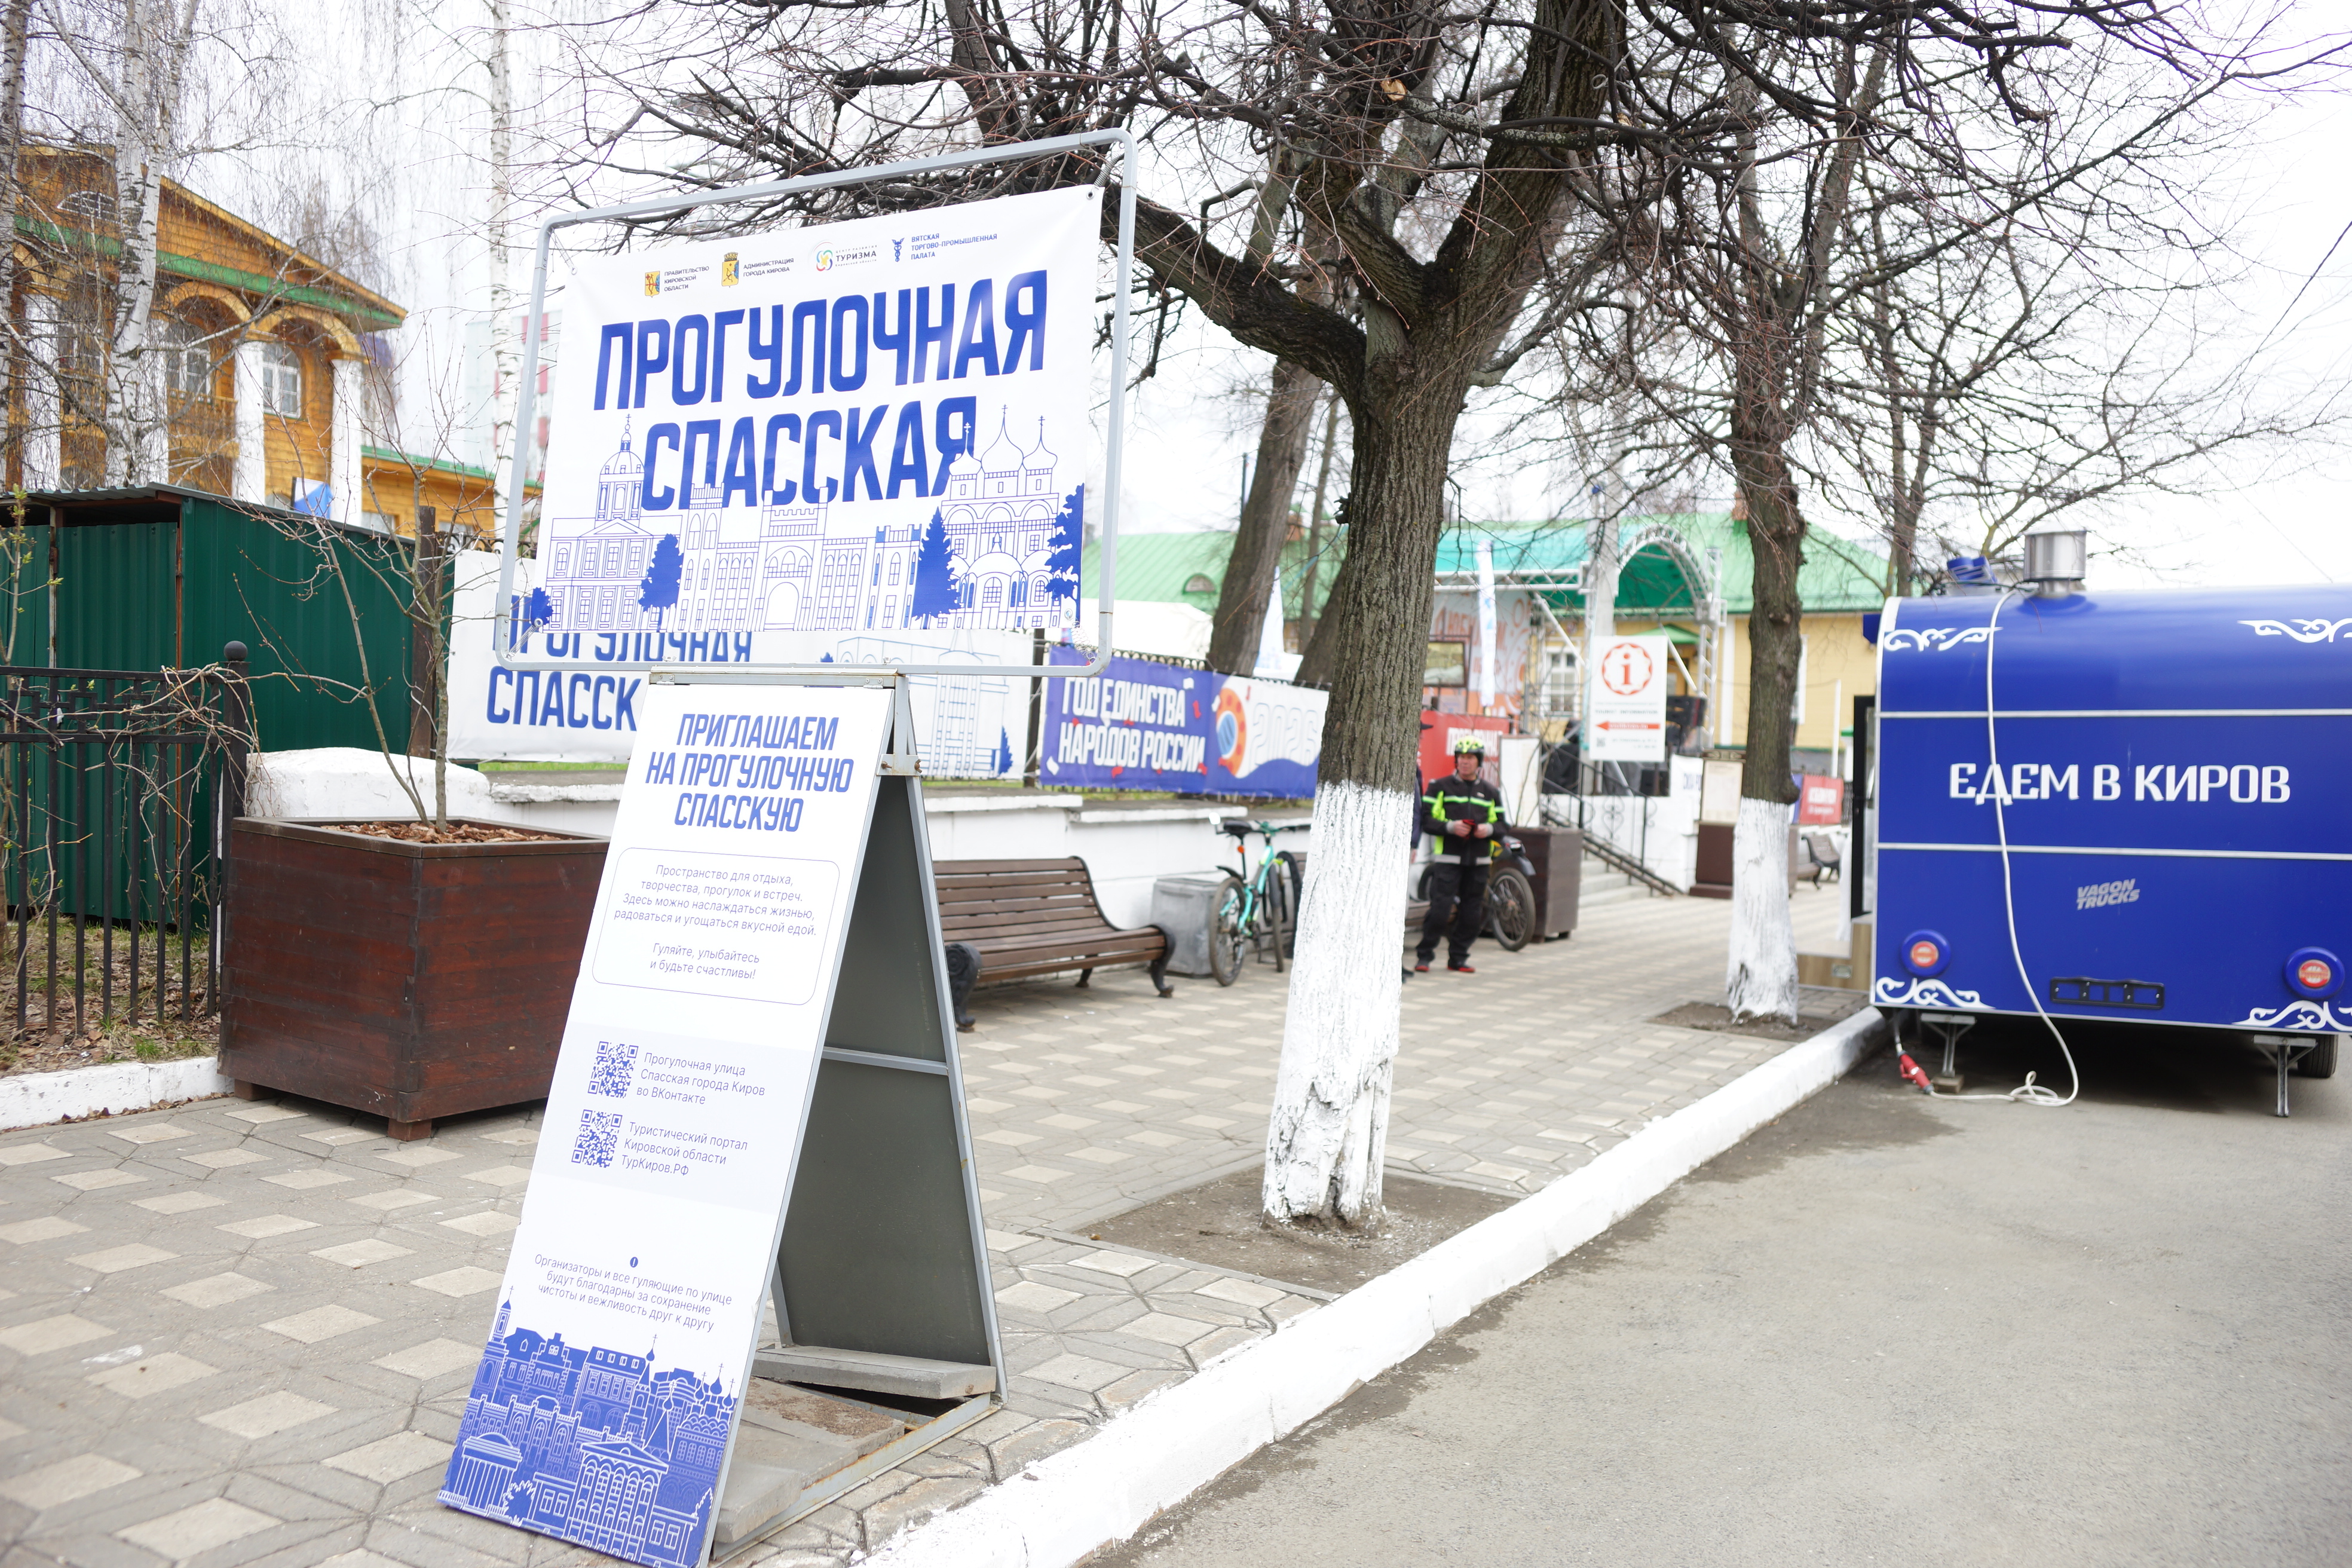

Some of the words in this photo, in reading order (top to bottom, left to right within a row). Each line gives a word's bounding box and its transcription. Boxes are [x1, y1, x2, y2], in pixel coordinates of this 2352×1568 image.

[911, 233, 939, 243] ВЯТСКАЯ
[911, 234, 997, 252] ТОРГОВО-ПРОМЫШЛЕННАЯ
[743, 258, 794, 269] АДМИНИСТРАЦИЯ
[836, 250, 877, 262] ТУРИЗМА
[911, 252, 936, 260] ПАЛАТА
[664, 266, 709, 277] ПРАВИТЕЛЬСТВО
[664, 274, 696, 284] КИРОВСКОЙ
[593, 269, 1048, 411] ПРОГУЛОЧНАЯ
[642, 396, 977, 511] СПАССКАЯ
[486, 666, 641, 731] СПАССК
[1062, 677, 1100, 718] ГОД
[1101, 678, 1186, 727] ЕДИНСТВА
[676, 713, 839, 751] ПРИГЛАШАЕМ
[1058, 721, 1141, 768] НАРОДОВ
[1141, 730, 1205, 773] РОССИИ
[645, 752, 676, 785] НА
[679, 753, 854, 792] ПРОГУЛОЧНУЮ
[1950, 763, 2080, 806] ЕДЕМ
[2093, 764, 2121, 801] В
[2134, 764, 2290, 803] КИРОВ
[674, 792, 804, 832] СПАССКУЮ
[656, 865, 728, 880] Пространство
[730, 872, 749, 882] для
[753, 874, 792, 886] отдыха,
[2077, 878, 2136, 898] VAGON
[642, 881, 700, 895] творчества,
[704, 887, 752, 898] прогулок
[763, 891, 802, 902] встреч.
[2076, 889, 2140, 910] TRUCKS
[623, 893, 652, 905] Здесь
[656, 899, 689, 908] можно
[692, 901, 767, 914] наслаждаться
[770, 908, 814, 921] жизнью,
[614, 911, 672, 922] радоваться
[684, 917, 739, 928] угощаться
[742, 921, 784, 932] вкусной
[788, 926, 816, 936] едой.
[653, 943, 694, 958] Гуляйте,
[697, 950, 759, 963] улыбайтесь
[659, 960, 693, 973] будьте
[697, 966, 755, 979] счастливы!
[644, 1052, 711, 1071] Прогулочная
[713, 1064, 745, 1077] улица
[641, 1069, 690, 1085] Спасская
[692, 1078, 728, 1092] города
[732, 1081, 765, 1096] Киров
[637, 1088, 648, 1096] во
[651, 1087, 705, 1104] ВКонтакте
[630, 1122, 708, 1144] Туристический
[710, 1137, 748, 1150] портал
[624, 1138, 680, 1157] Кировской
[683, 1149, 726, 1165] области
[622, 1154, 688, 1176] ТурКиров.РФ
[535, 1254, 602, 1278] Организаторы
[613, 1273, 630, 1283] все
[632, 1277, 683, 1294] гуляющие
[686, 1288, 698, 1297] по
[700, 1291, 731, 1306] улице
[547, 1270, 574, 1286] будут
[577, 1277, 635, 1298] благодарны
[637, 1292, 648, 1301] за
[651, 1296, 710, 1315] сохранение
[539, 1285, 577, 1300] чистоты
[588, 1296, 647, 1315] вежливость
[649, 1310, 673, 1322] друг
[675, 1315, 682, 1323] к
[683, 1317, 714, 1333] другу
